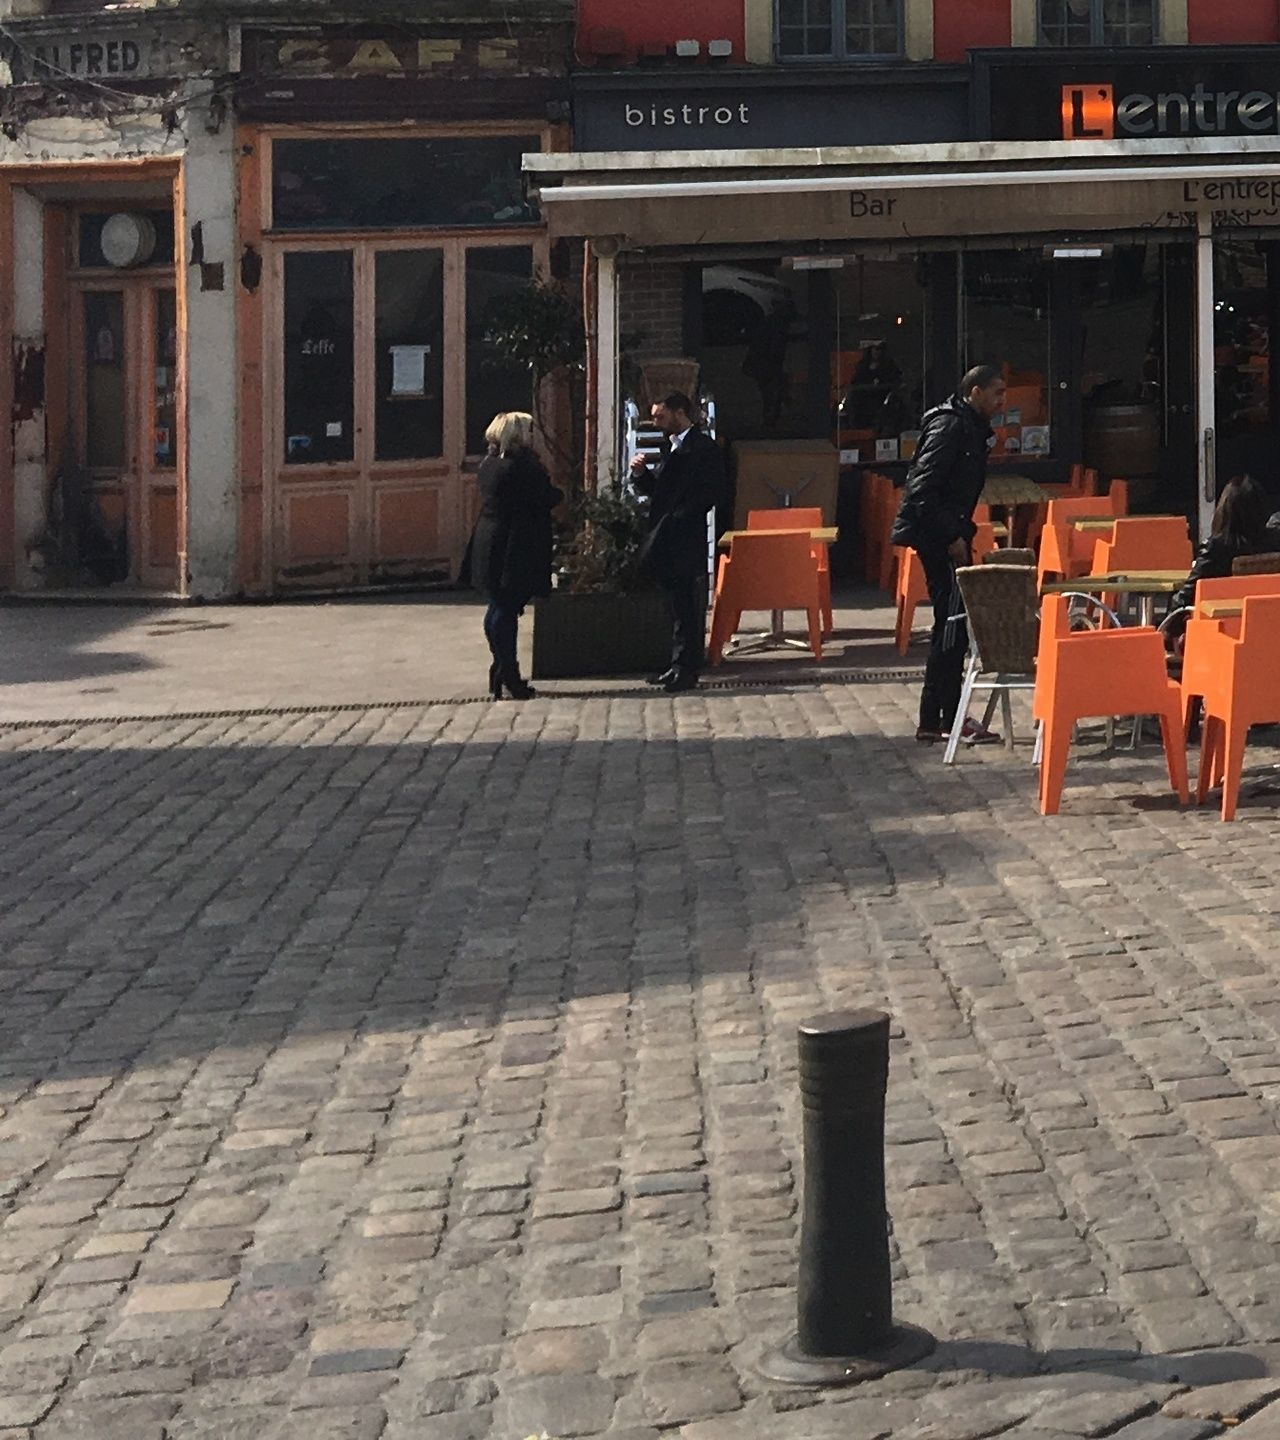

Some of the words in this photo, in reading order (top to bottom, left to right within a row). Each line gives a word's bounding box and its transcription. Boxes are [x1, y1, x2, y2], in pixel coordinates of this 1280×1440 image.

[33, 39, 141, 76] ALFRED
[626, 102, 750, 126] bistrot
[850, 192, 897, 218] Bar
[301, 339, 335, 355] Leffe
